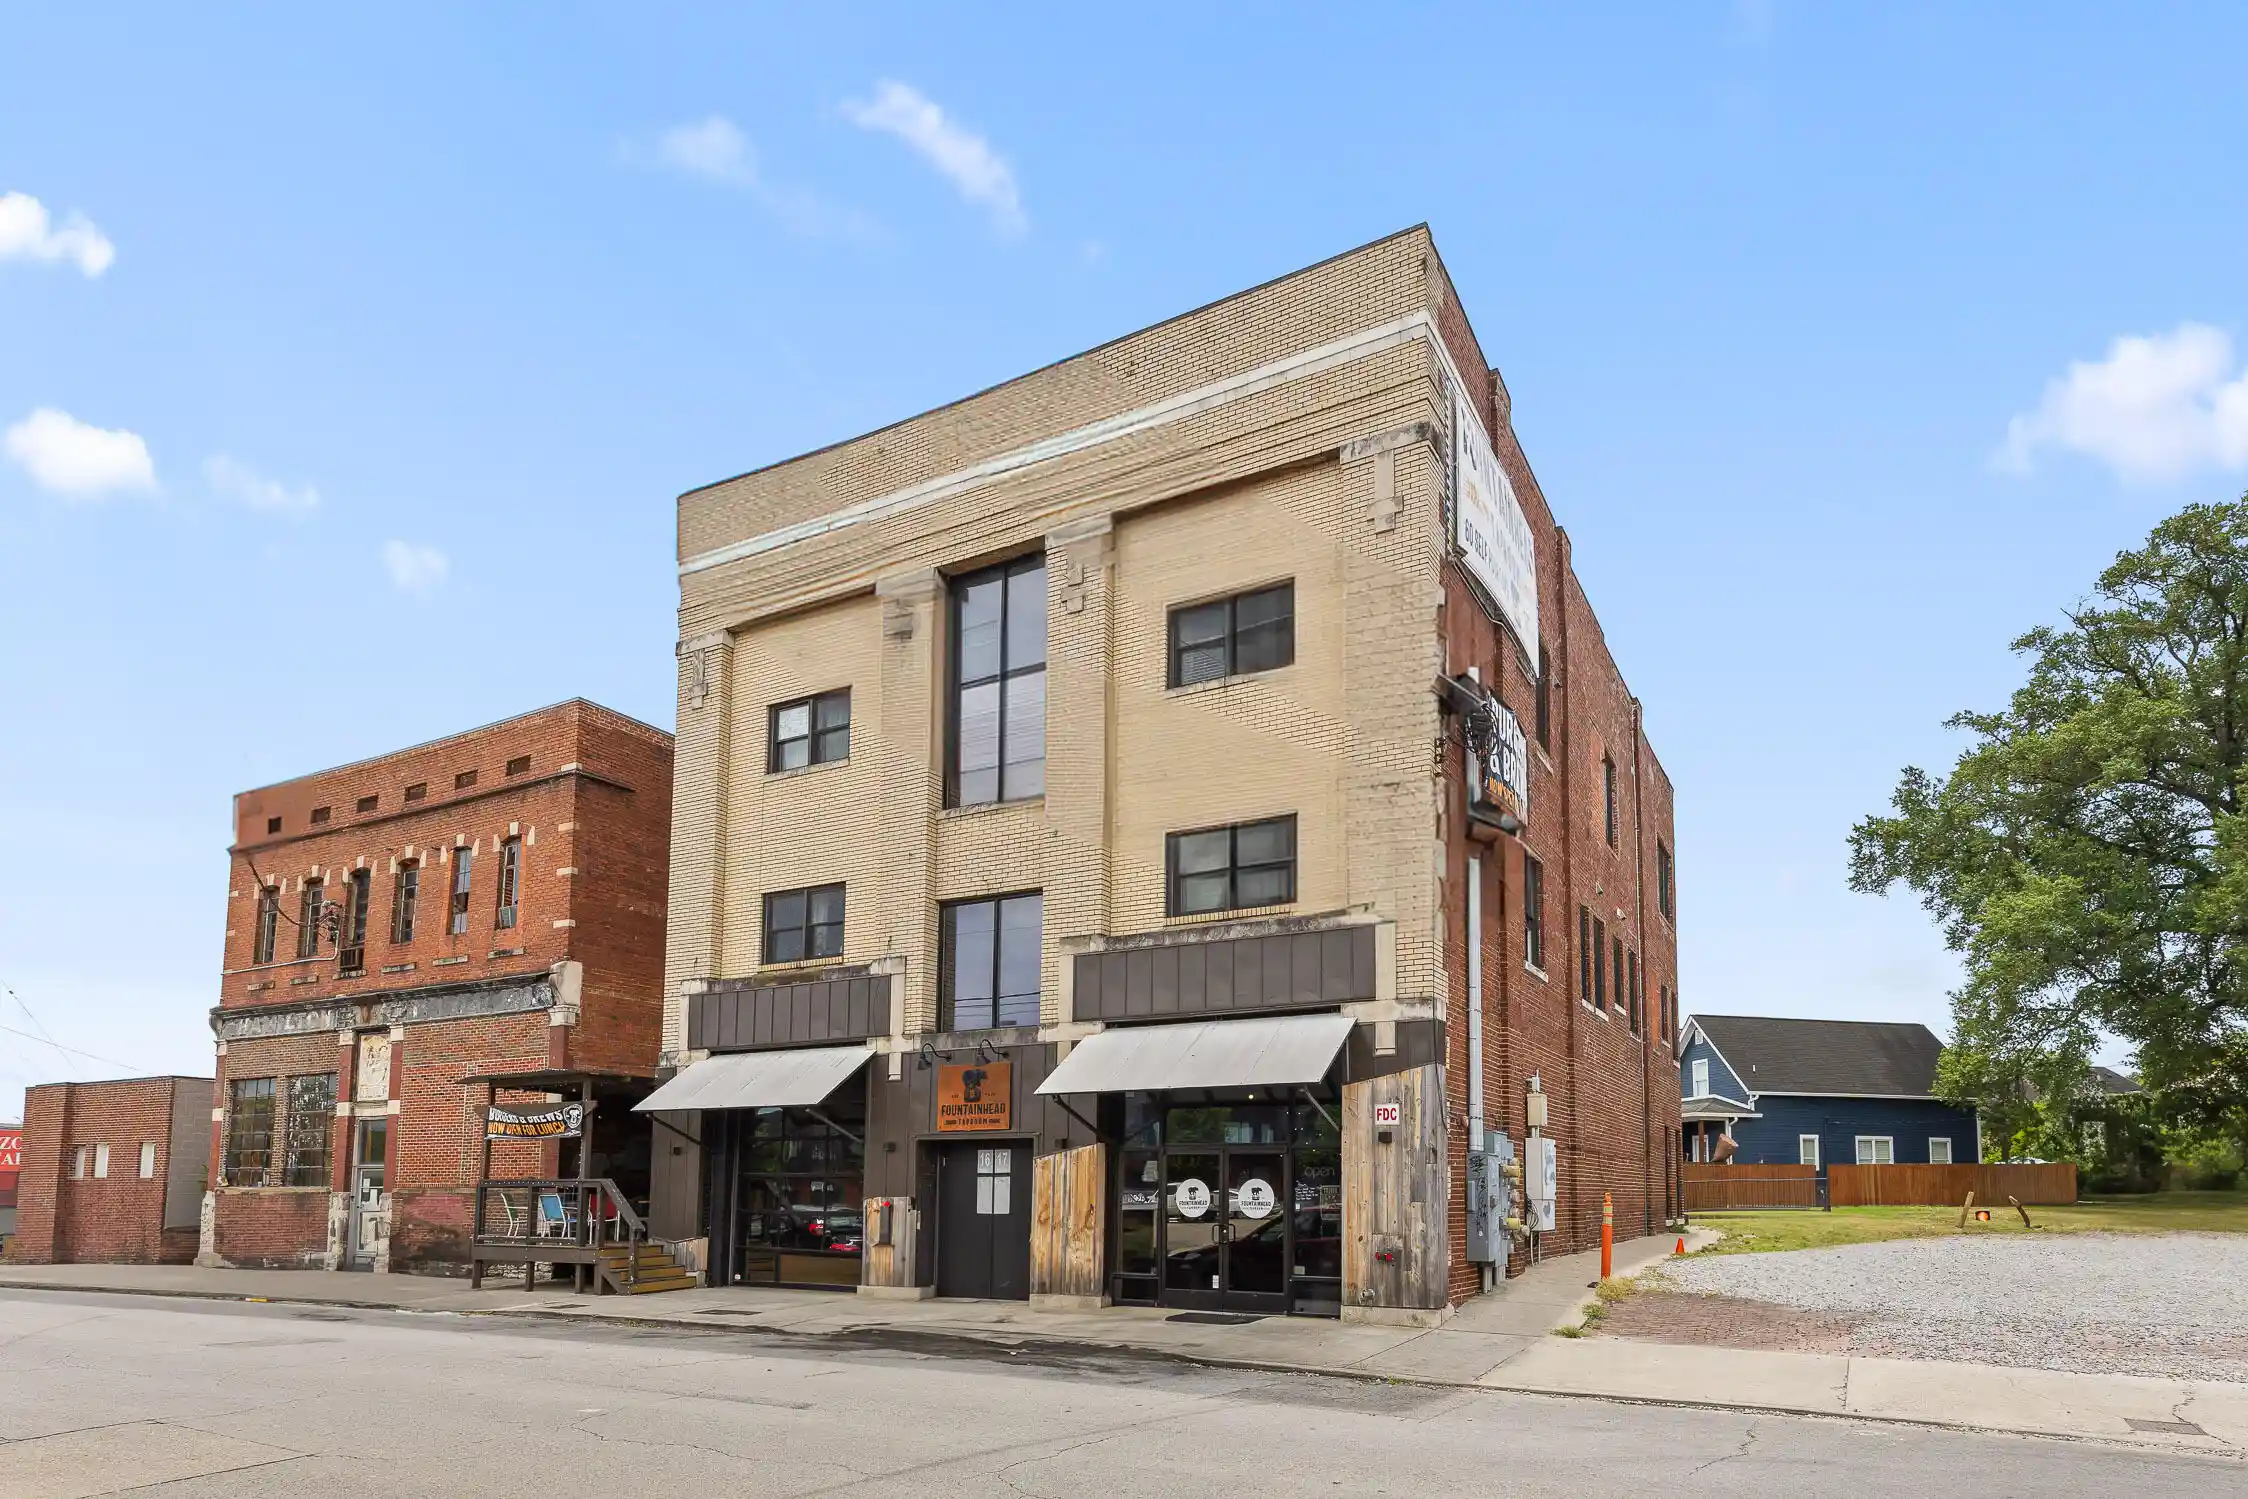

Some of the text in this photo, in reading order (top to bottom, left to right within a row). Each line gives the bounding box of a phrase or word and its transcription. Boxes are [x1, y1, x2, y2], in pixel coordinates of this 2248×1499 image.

[1465, 519, 1488, 563] 60 SELF
[942, 1103, 1006, 1116] FOUNTAINHEAD
[1377, 1108, 1397, 1121] FDC
[488, 1122, 505, 1134] NOW
[522, 1124, 537, 1136] FOR
[537, 1121, 565, 1135] LUNCH
